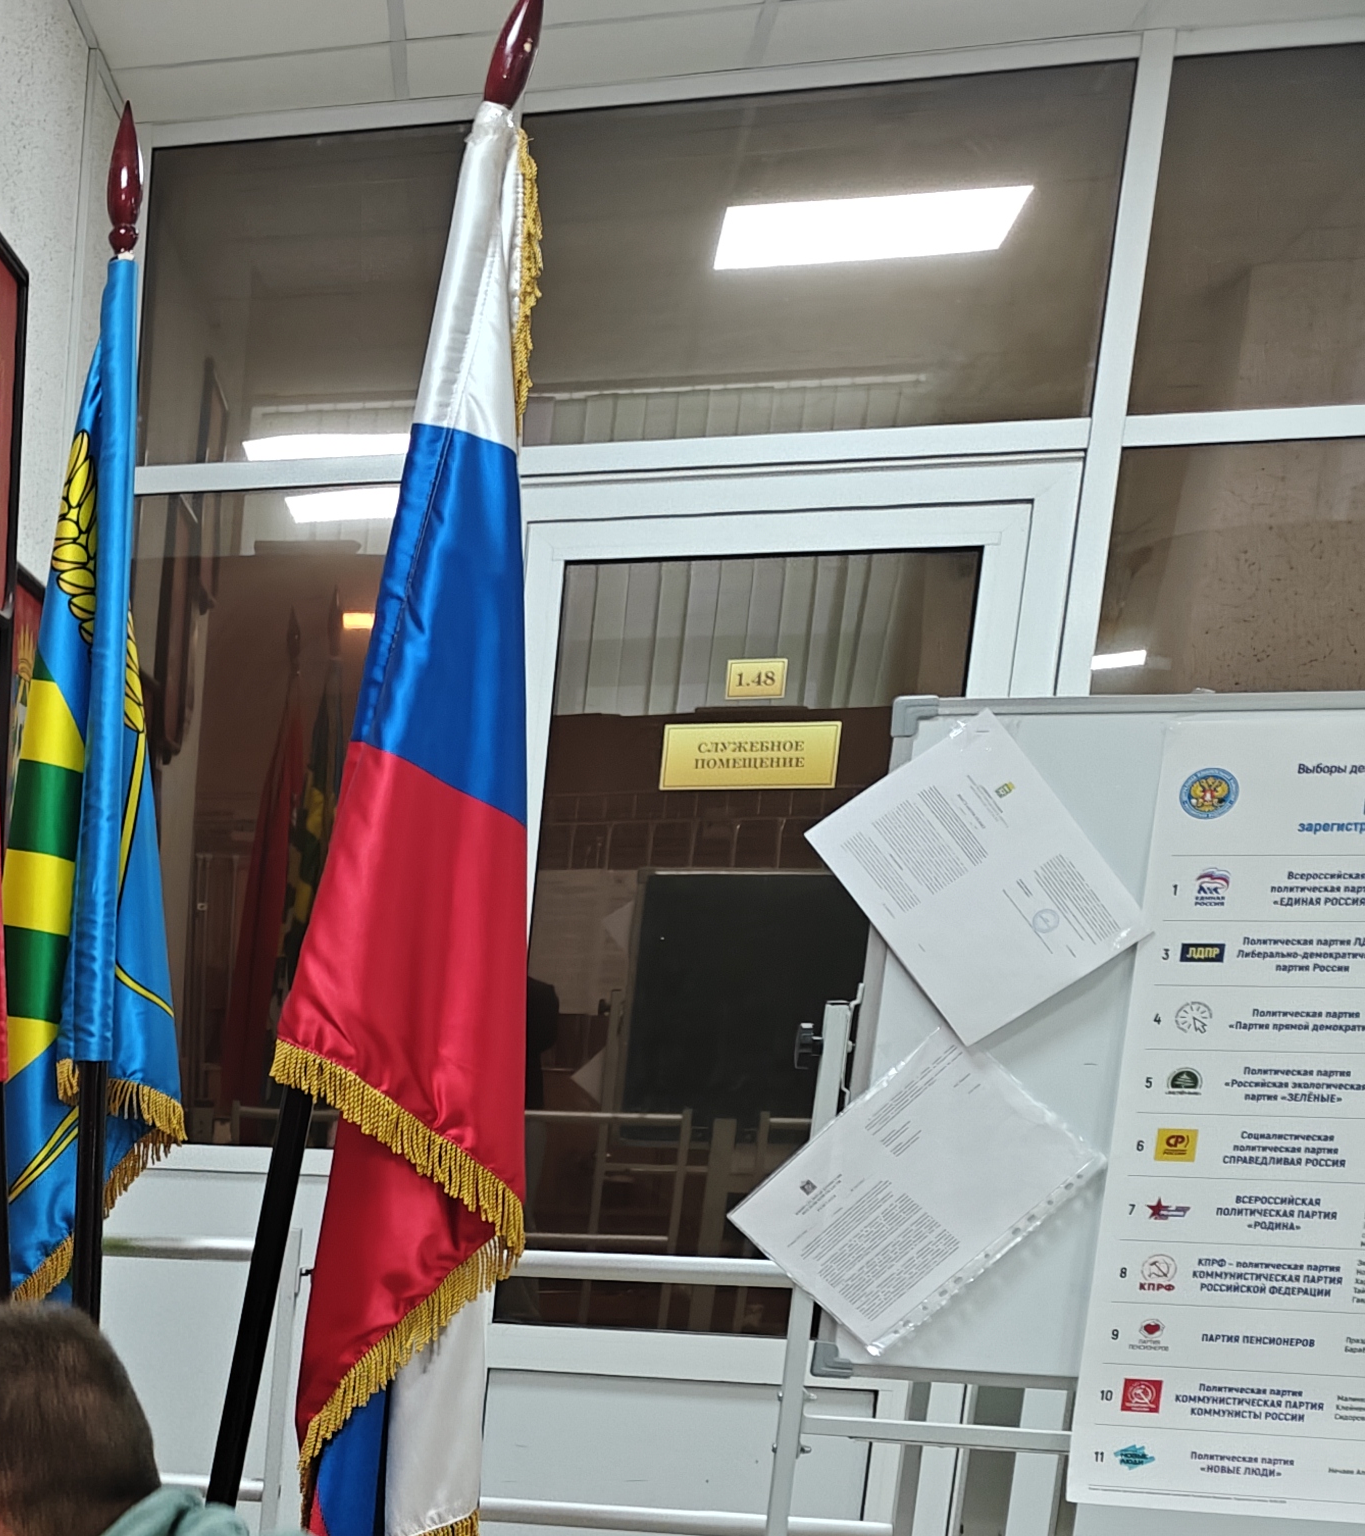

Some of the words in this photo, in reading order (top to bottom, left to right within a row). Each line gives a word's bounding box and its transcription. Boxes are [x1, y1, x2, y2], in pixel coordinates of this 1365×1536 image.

[735, 671, 776, 688] 1.48
[698, 740, 805, 754] СЛУЖЕБНОЕ
[694, 757, 805, 770] ПОМЕЩЕНИЕ
[1297, 762, 1347, 776] Выборы
[1172, 884, 1178, 896] 1
[1270, 885, 1341, 894] политическая
[1273, 897, 1321, 907] «ЕДИНАЯ
[1242, 936, 1313, 946] Политическая
[1316, 938, 1351, 948] партия
[1162, 949, 1171, 960] 3
[1186, 947, 1220, 959] ЛДПР
[1276, 964, 1310, 974] партия
[1312, 963, 1350, 973] России
[1153, 1013, 1162, 1025] 4
[1252, 1008, 1322, 1018] Политическая
[1325, 1010, 1360, 1020] партия
[1228, 1021, 1270, 1032] «Партия
[1272, 1021, 1309, 1033] прямой
[1243, 1066, 1314, 1077] Политическая
[1316, 1069, 1351, 1079] партия
[1145, 1077, 1153, 1089] 5
[1224, 1079, 1289, 1089] «Российская
[1244, 1093, 1278, 1103] партия
[1280, 1091, 1343, 1103] «ЗЕЛЁНЫЕ»
[1241, 1130, 1335, 1142] Социалистическая
[1136, 1140, 1145, 1152] 6
[1233, 1144, 1302, 1154] политическая
[1304, 1146, 1339, 1156] партия
[1222, 1156, 1302, 1167] СПРАВЕДЛИВАЯ
[1305, 1158, 1346, 1168] РОССИЯ
[1235, 1195, 1321, 1207] ВСЕРОССИЙСКАЯ
[1128, 1203, 1136, 1215] 7
[1216, 1207, 1295, 1218] ПОЛИТИЧЕСКАЯ
[1297, 1210, 1338, 1221] ПАРТИЯ
[1247, 1221, 1301, 1232] «РОДИНА»
[1197, 1258, 1226, 1268] КПРФ
[1236, 1261, 1304, 1272] политическая
[1306, 1263, 1341, 1273] партия
[1119, 1267, 1127, 1278] 8
[1192, 1270, 1301, 1283] КОММУНИСТИЧЕСКАЯ
[1303, 1275, 1343, 1286] ПАРТИЯ
[1139, 1282, 1175, 1292] КПРФ
[1200, 1283, 1266, 1295] РОССИЙСКОЙ
[1269, 1287, 1332, 1298] ФЕДЕРАЦИИ
[1111, 1329, 1119, 1340] 9
[1201, 1333, 1240, 1344] ПАРТИЯ
[1242, 1336, 1315, 1348] ПЕНСИОНЕРОВ
[1100, 1390, 1113, 1401] 10
[1199, 1383, 1267, 1395] Политическая
[1269, 1386, 1303, 1398] партия
[1175, 1394, 1282, 1408] КОММУНИСТИЧЕСКАЯ
[1284, 1400, 1324, 1411] ПАРТИЯ
[1190, 1407, 1263, 1420] КОММУНИСТЫ
[1265, 1411, 1305, 1422] РОССИИ
[1094, 1451, 1104, 1462] 11
[1190, 1451, 1259, 1464] Политическая
[1261, 1456, 1294, 1467] партия
[1200, 1464, 1241, 1475] «НОВЫЕ
[1243, 1466, 1282, 1478] ЛЮДИ»
